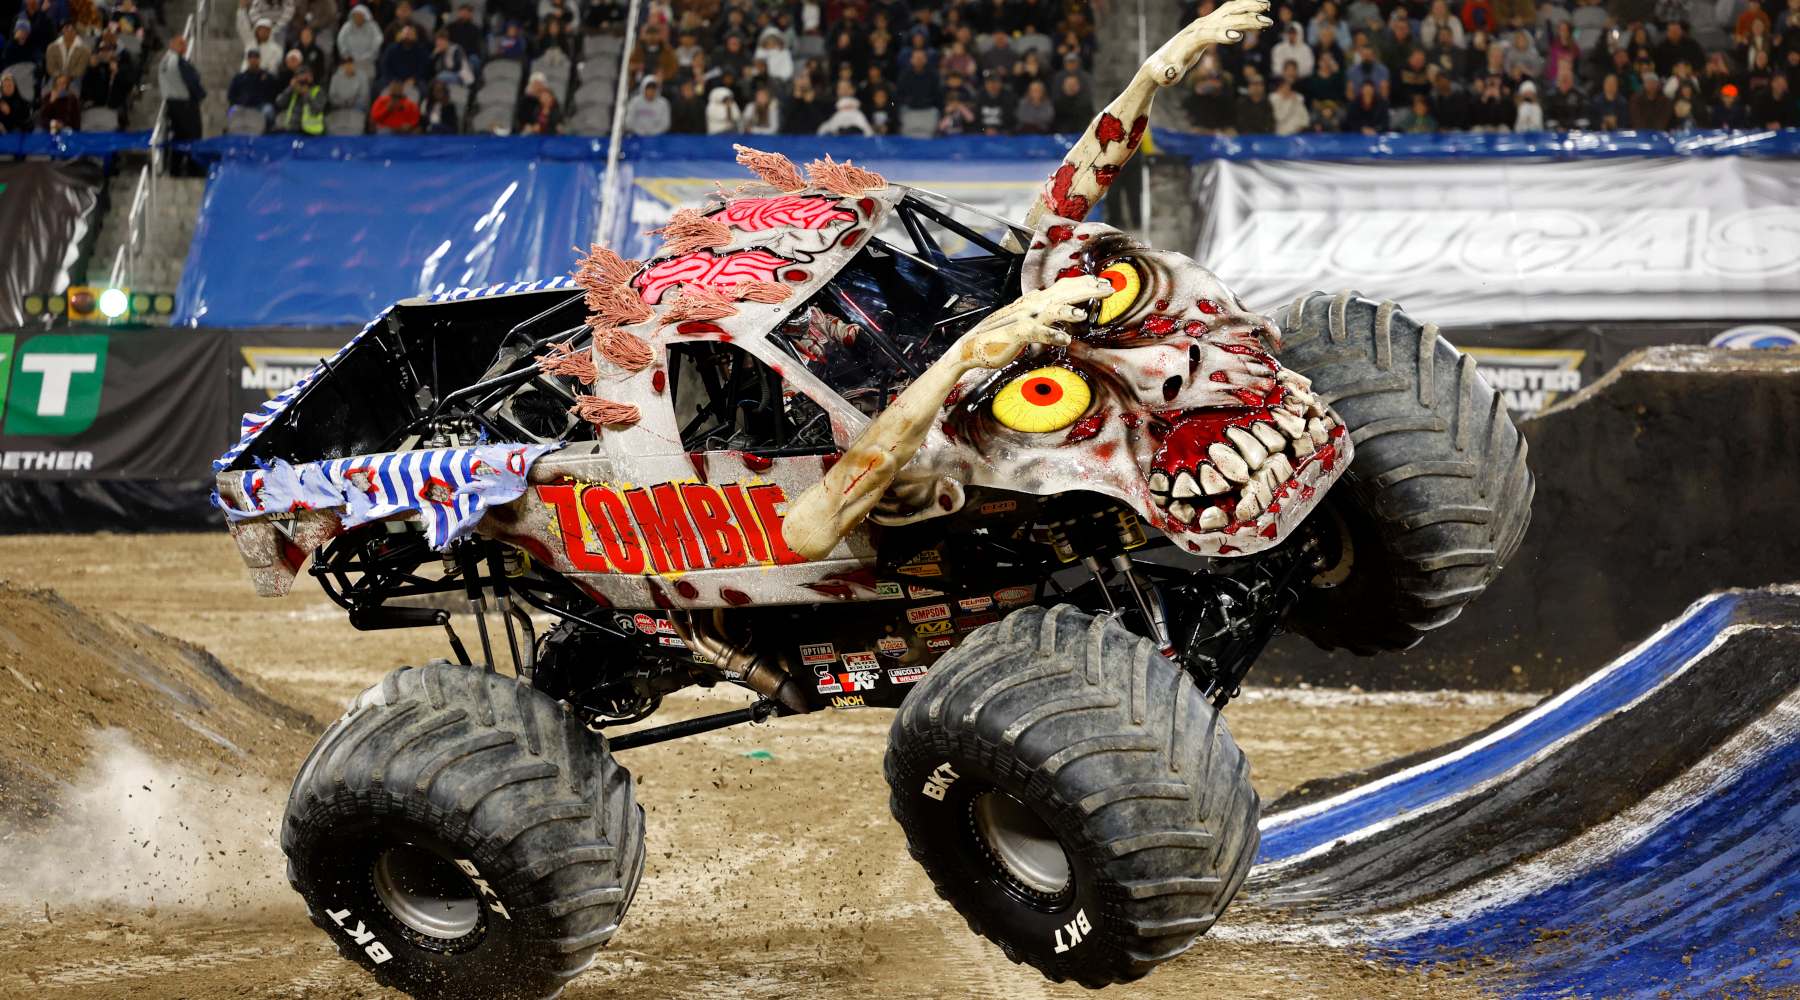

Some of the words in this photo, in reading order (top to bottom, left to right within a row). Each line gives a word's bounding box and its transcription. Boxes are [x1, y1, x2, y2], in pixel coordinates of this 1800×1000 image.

[1207, 205, 1800, 279] LUCAS
[241, 366, 314, 389] MON
[0, 451, 93, 470] ETHER
[534, 482, 812, 575] ZOMBIE
[911, 606, 946, 621] SIMPSON
[803, 646, 832, 656] OPTIMA
[926, 639, 951, 648] Coan
[890, 668, 922, 677] LINCOLN
[831, 695, 865, 707] UNOH
[922, 762, 960, 802] BKT
[455, 859, 511, 920] BKT
[325, 908, 393, 964] BKT
[1053, 908, 1092, 954] BKT
